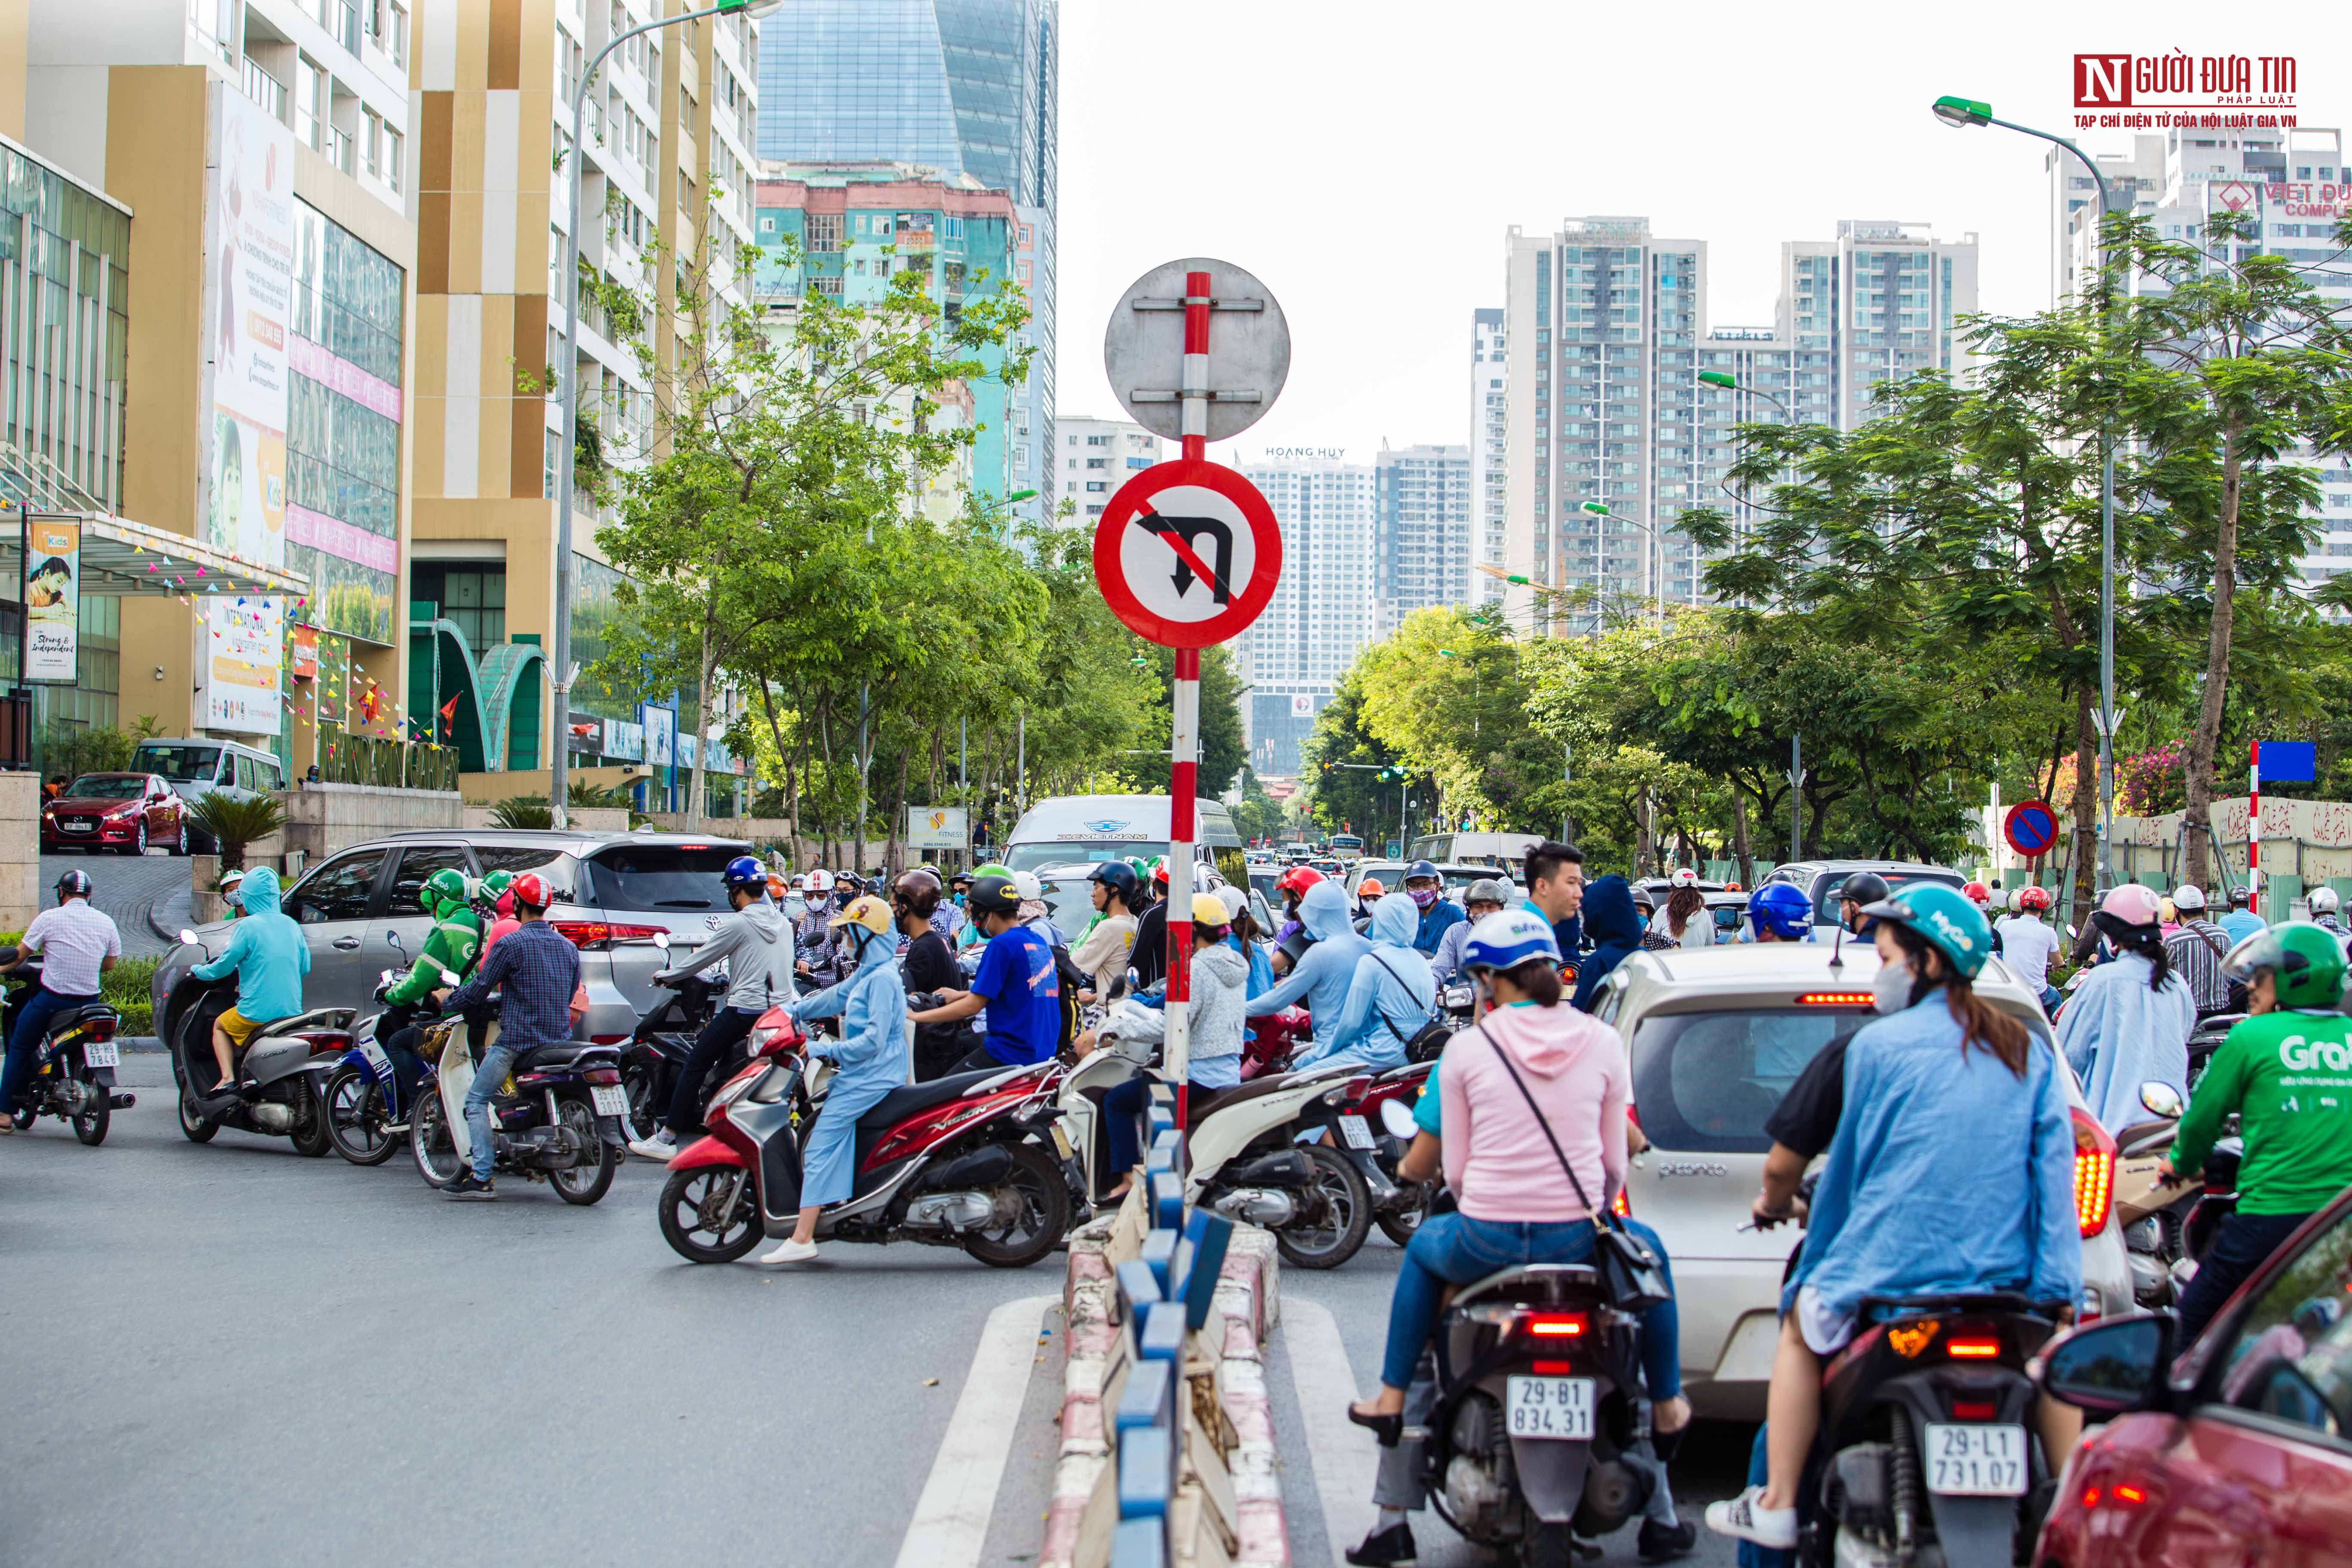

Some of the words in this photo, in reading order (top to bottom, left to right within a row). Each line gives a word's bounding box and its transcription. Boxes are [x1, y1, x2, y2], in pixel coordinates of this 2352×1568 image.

[2263, 182, 2313, 201] VIET
[1266, 447, 1313, 456] HOANG
[1318, 448, 1345, 457] HUY
[48, 537, 67, 546] Kids
[38, 634, 61, 646] Strong
[64, 636, 69, 644] &
[31, 643, 74, 653] Independent
[89, 1044, 114, 1054] 29-H9
[91, 1055, 116, 1066] 7848
[600, 1100, 625, 1113] 3013
[928, 1106, 988, 1130] VISION
[1522, 1380, 1579, 1406] 29-B1
[1515, 1407, 1586, 1433] 834.31
[1943, 1428, 2008, 1457] 29-L1
[1936, 1458, 2017, 1487] 731.07
